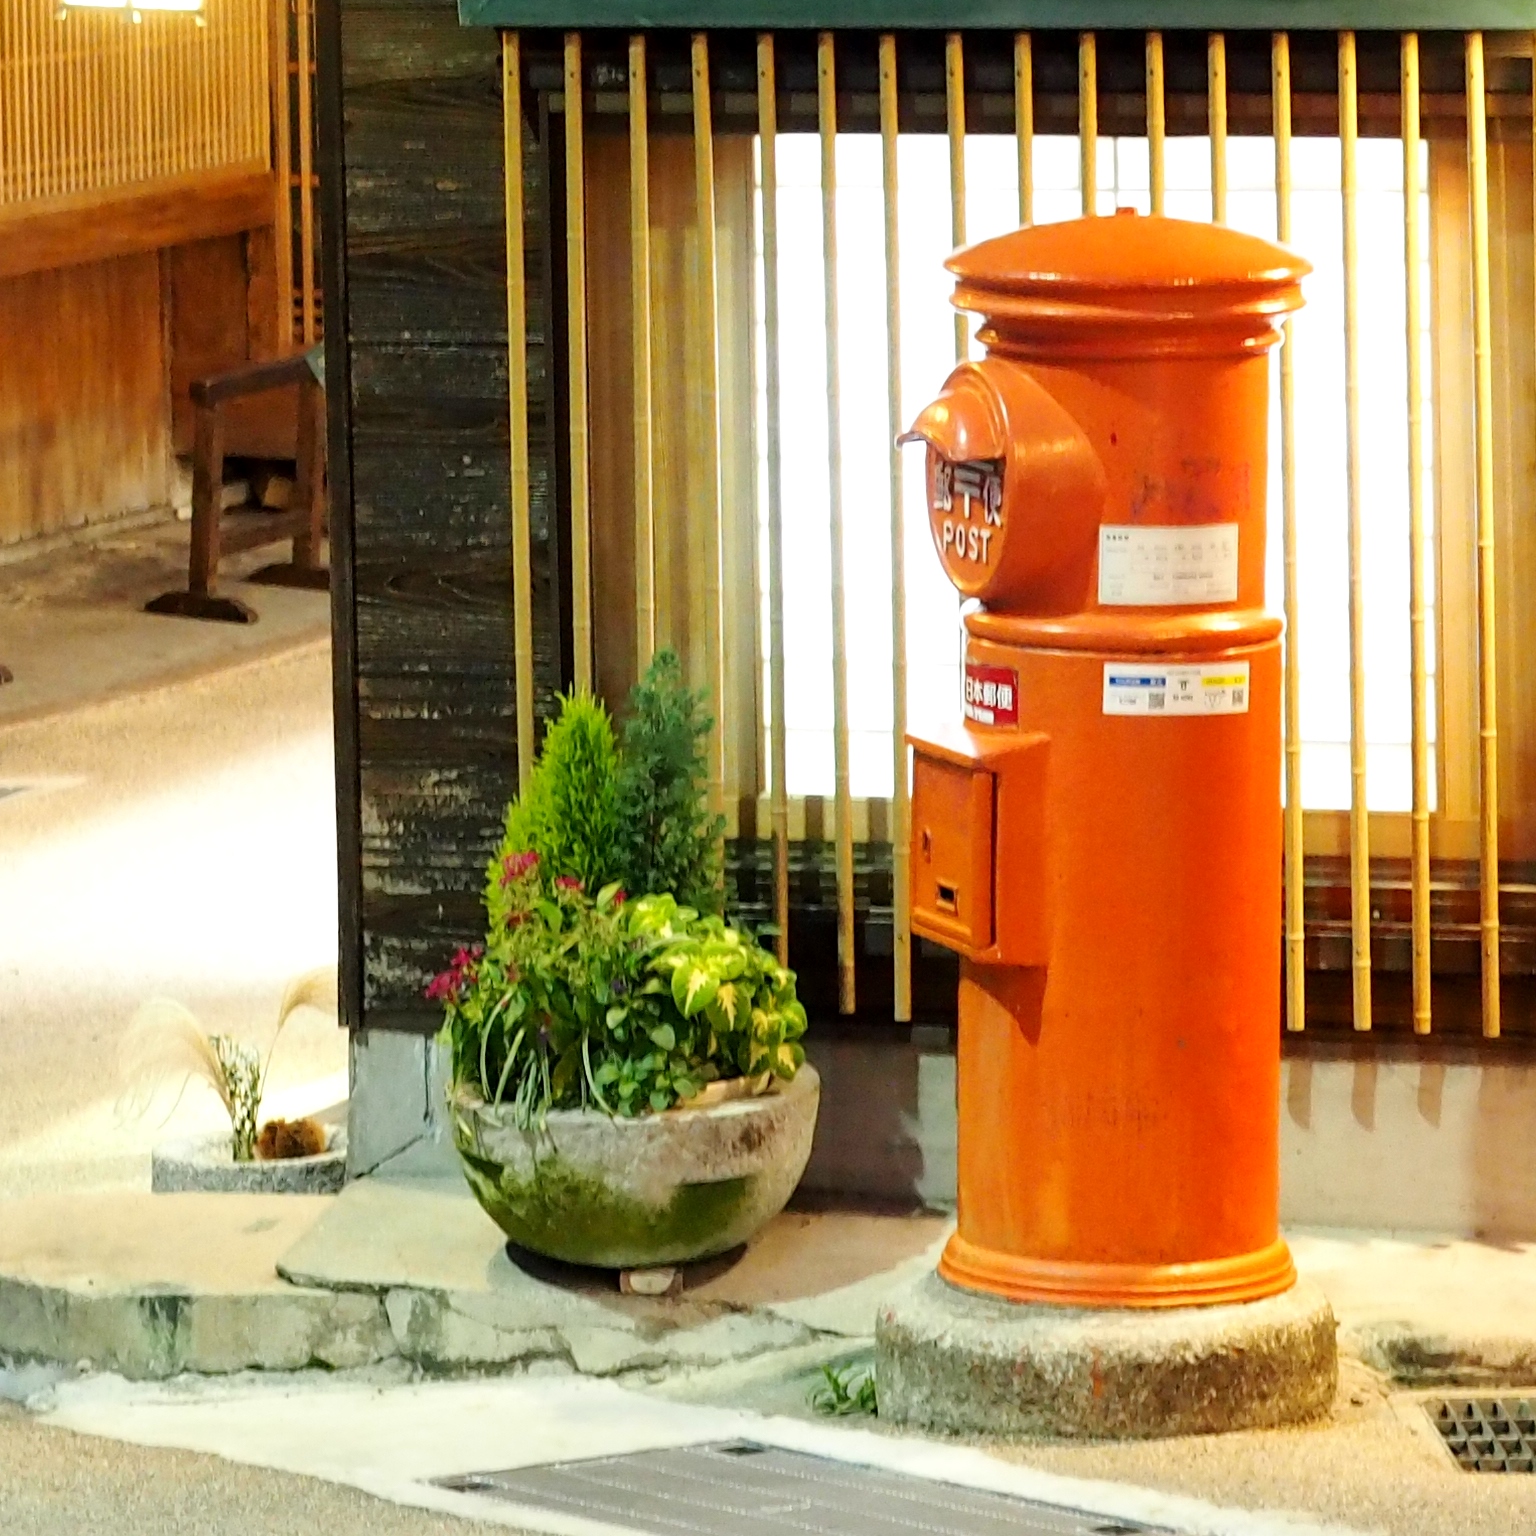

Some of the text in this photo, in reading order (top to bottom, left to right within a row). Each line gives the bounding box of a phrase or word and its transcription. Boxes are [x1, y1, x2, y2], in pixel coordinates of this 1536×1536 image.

[943, 520, 991, 564] POST
[966, 676, 1013, 711] 日本郵便
